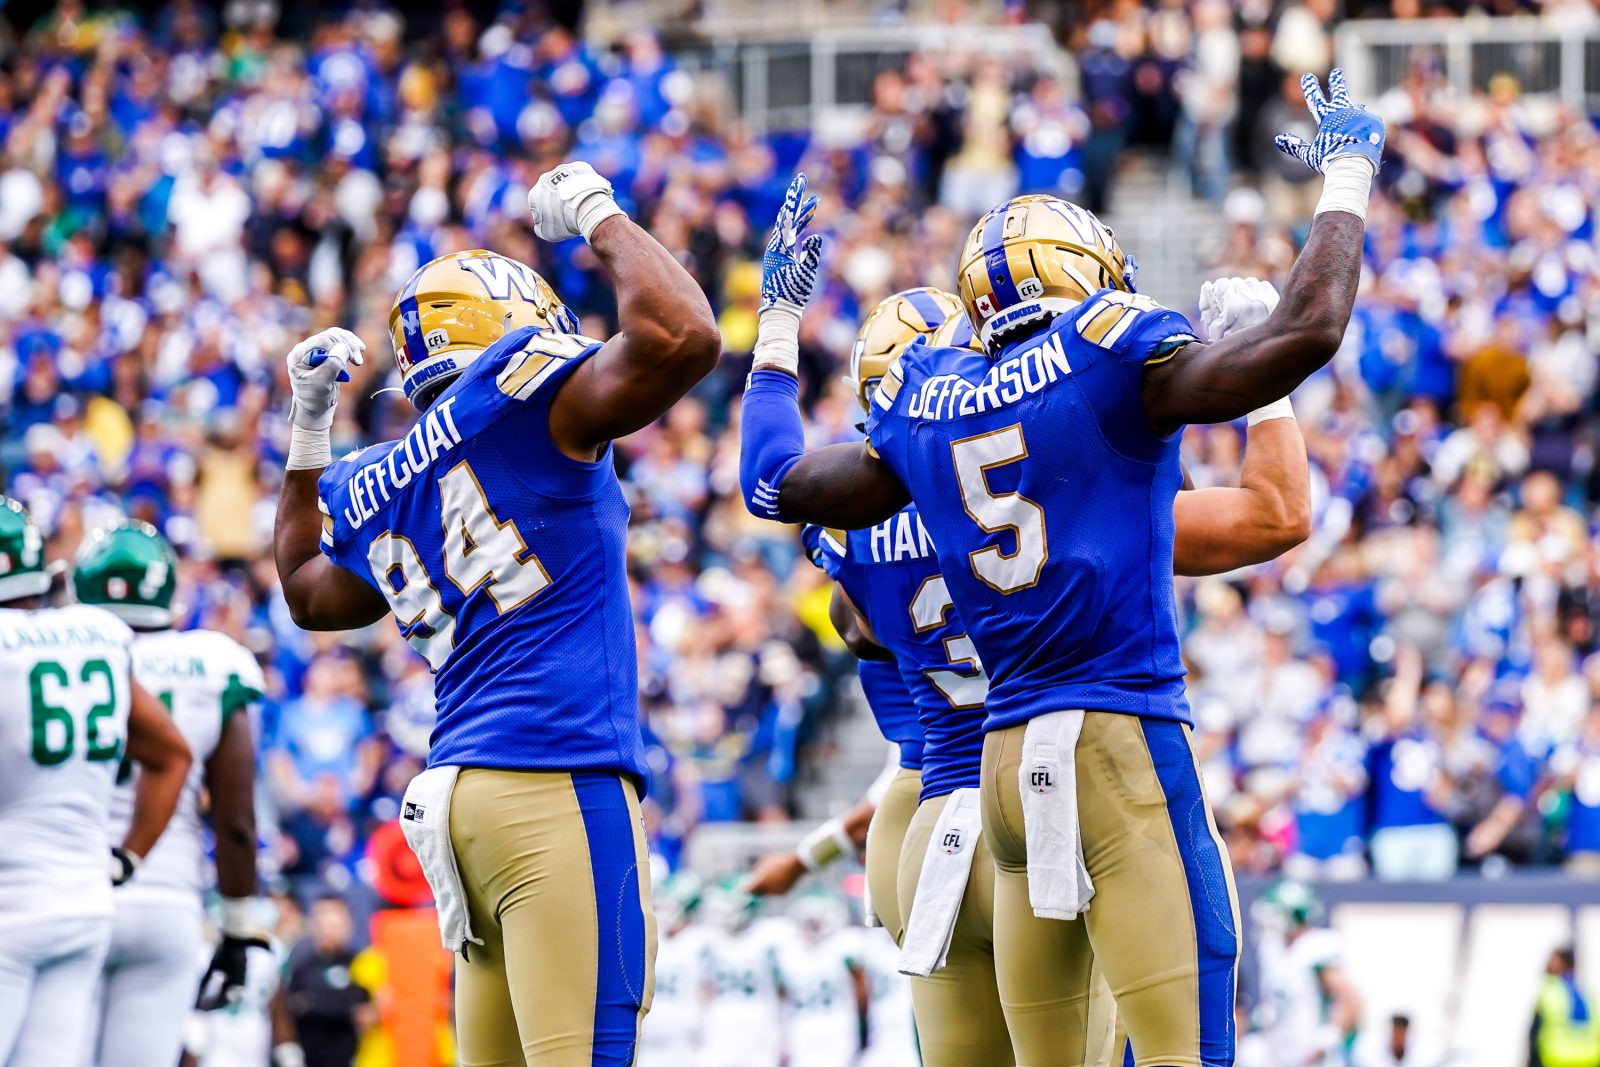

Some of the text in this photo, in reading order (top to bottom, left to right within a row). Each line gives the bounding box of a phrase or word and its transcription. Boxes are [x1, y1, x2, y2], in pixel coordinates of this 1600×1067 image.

[550, 172, 569, 186] CFL
[457, 256, 539, 303] W
[1021, 283, 1040, 297] CFL
[428, 334, 446, 348] CFL
[411, 358, 457, 386] BOMBERS
[908, 332, 1073, 419] JEFFERSON
[344, 395, 464, 530] JEFFCOAT
[950, 421, 1049, 596] 5
[366, 459, 554, 674] 94
[28, 659, 122, 767] 62
[1031, 772, 1053, 787] CFL
[942, 833, 961, 848] CFL
